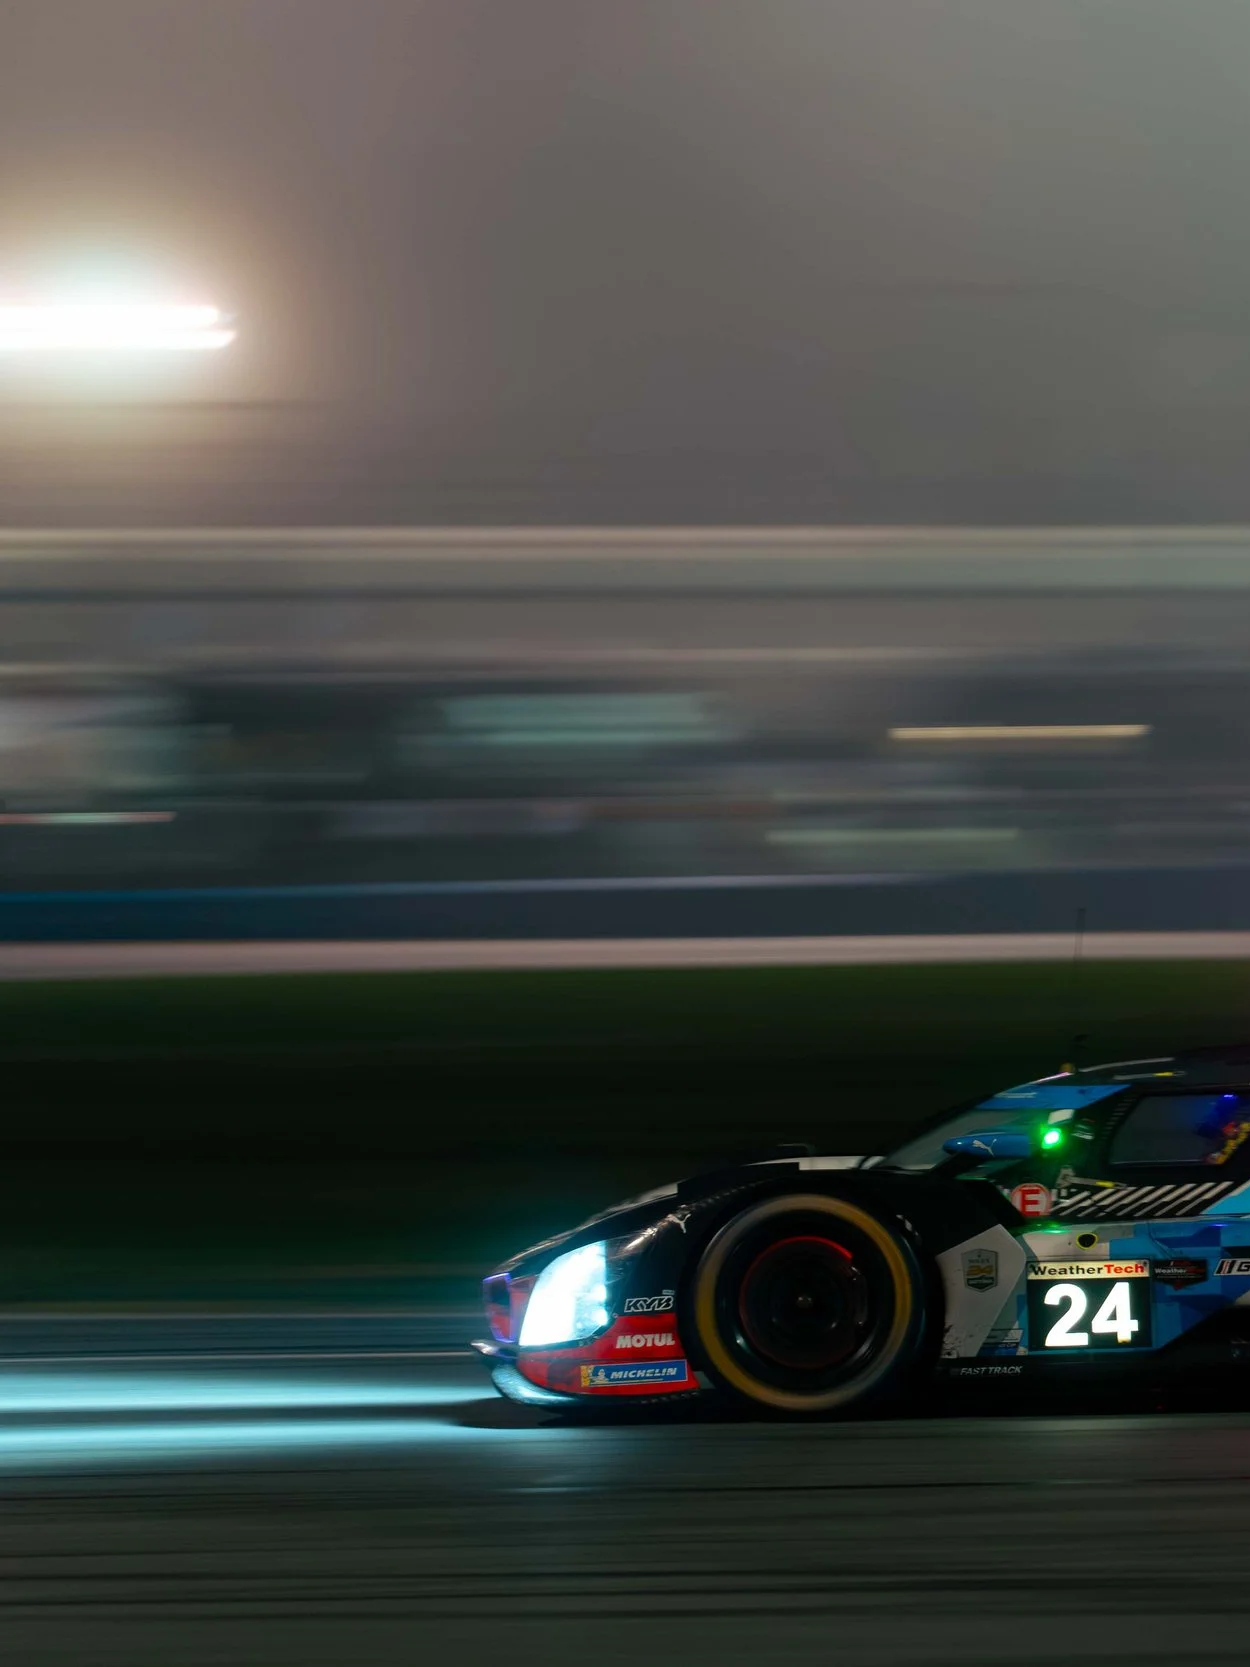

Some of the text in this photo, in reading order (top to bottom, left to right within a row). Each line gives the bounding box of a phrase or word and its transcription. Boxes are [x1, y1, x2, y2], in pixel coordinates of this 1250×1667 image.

[1020, 1188, 1041, 1217] E
[1033, 1263, 1145, 1275] WeatherTech
[624, 1296, 674, 1312] KYB
[1043, 1281, 1139, 1347] 24
[616, 1333, 675, 1348] MOTUL
[610, 1368, 677, 1379] MICHELIN
